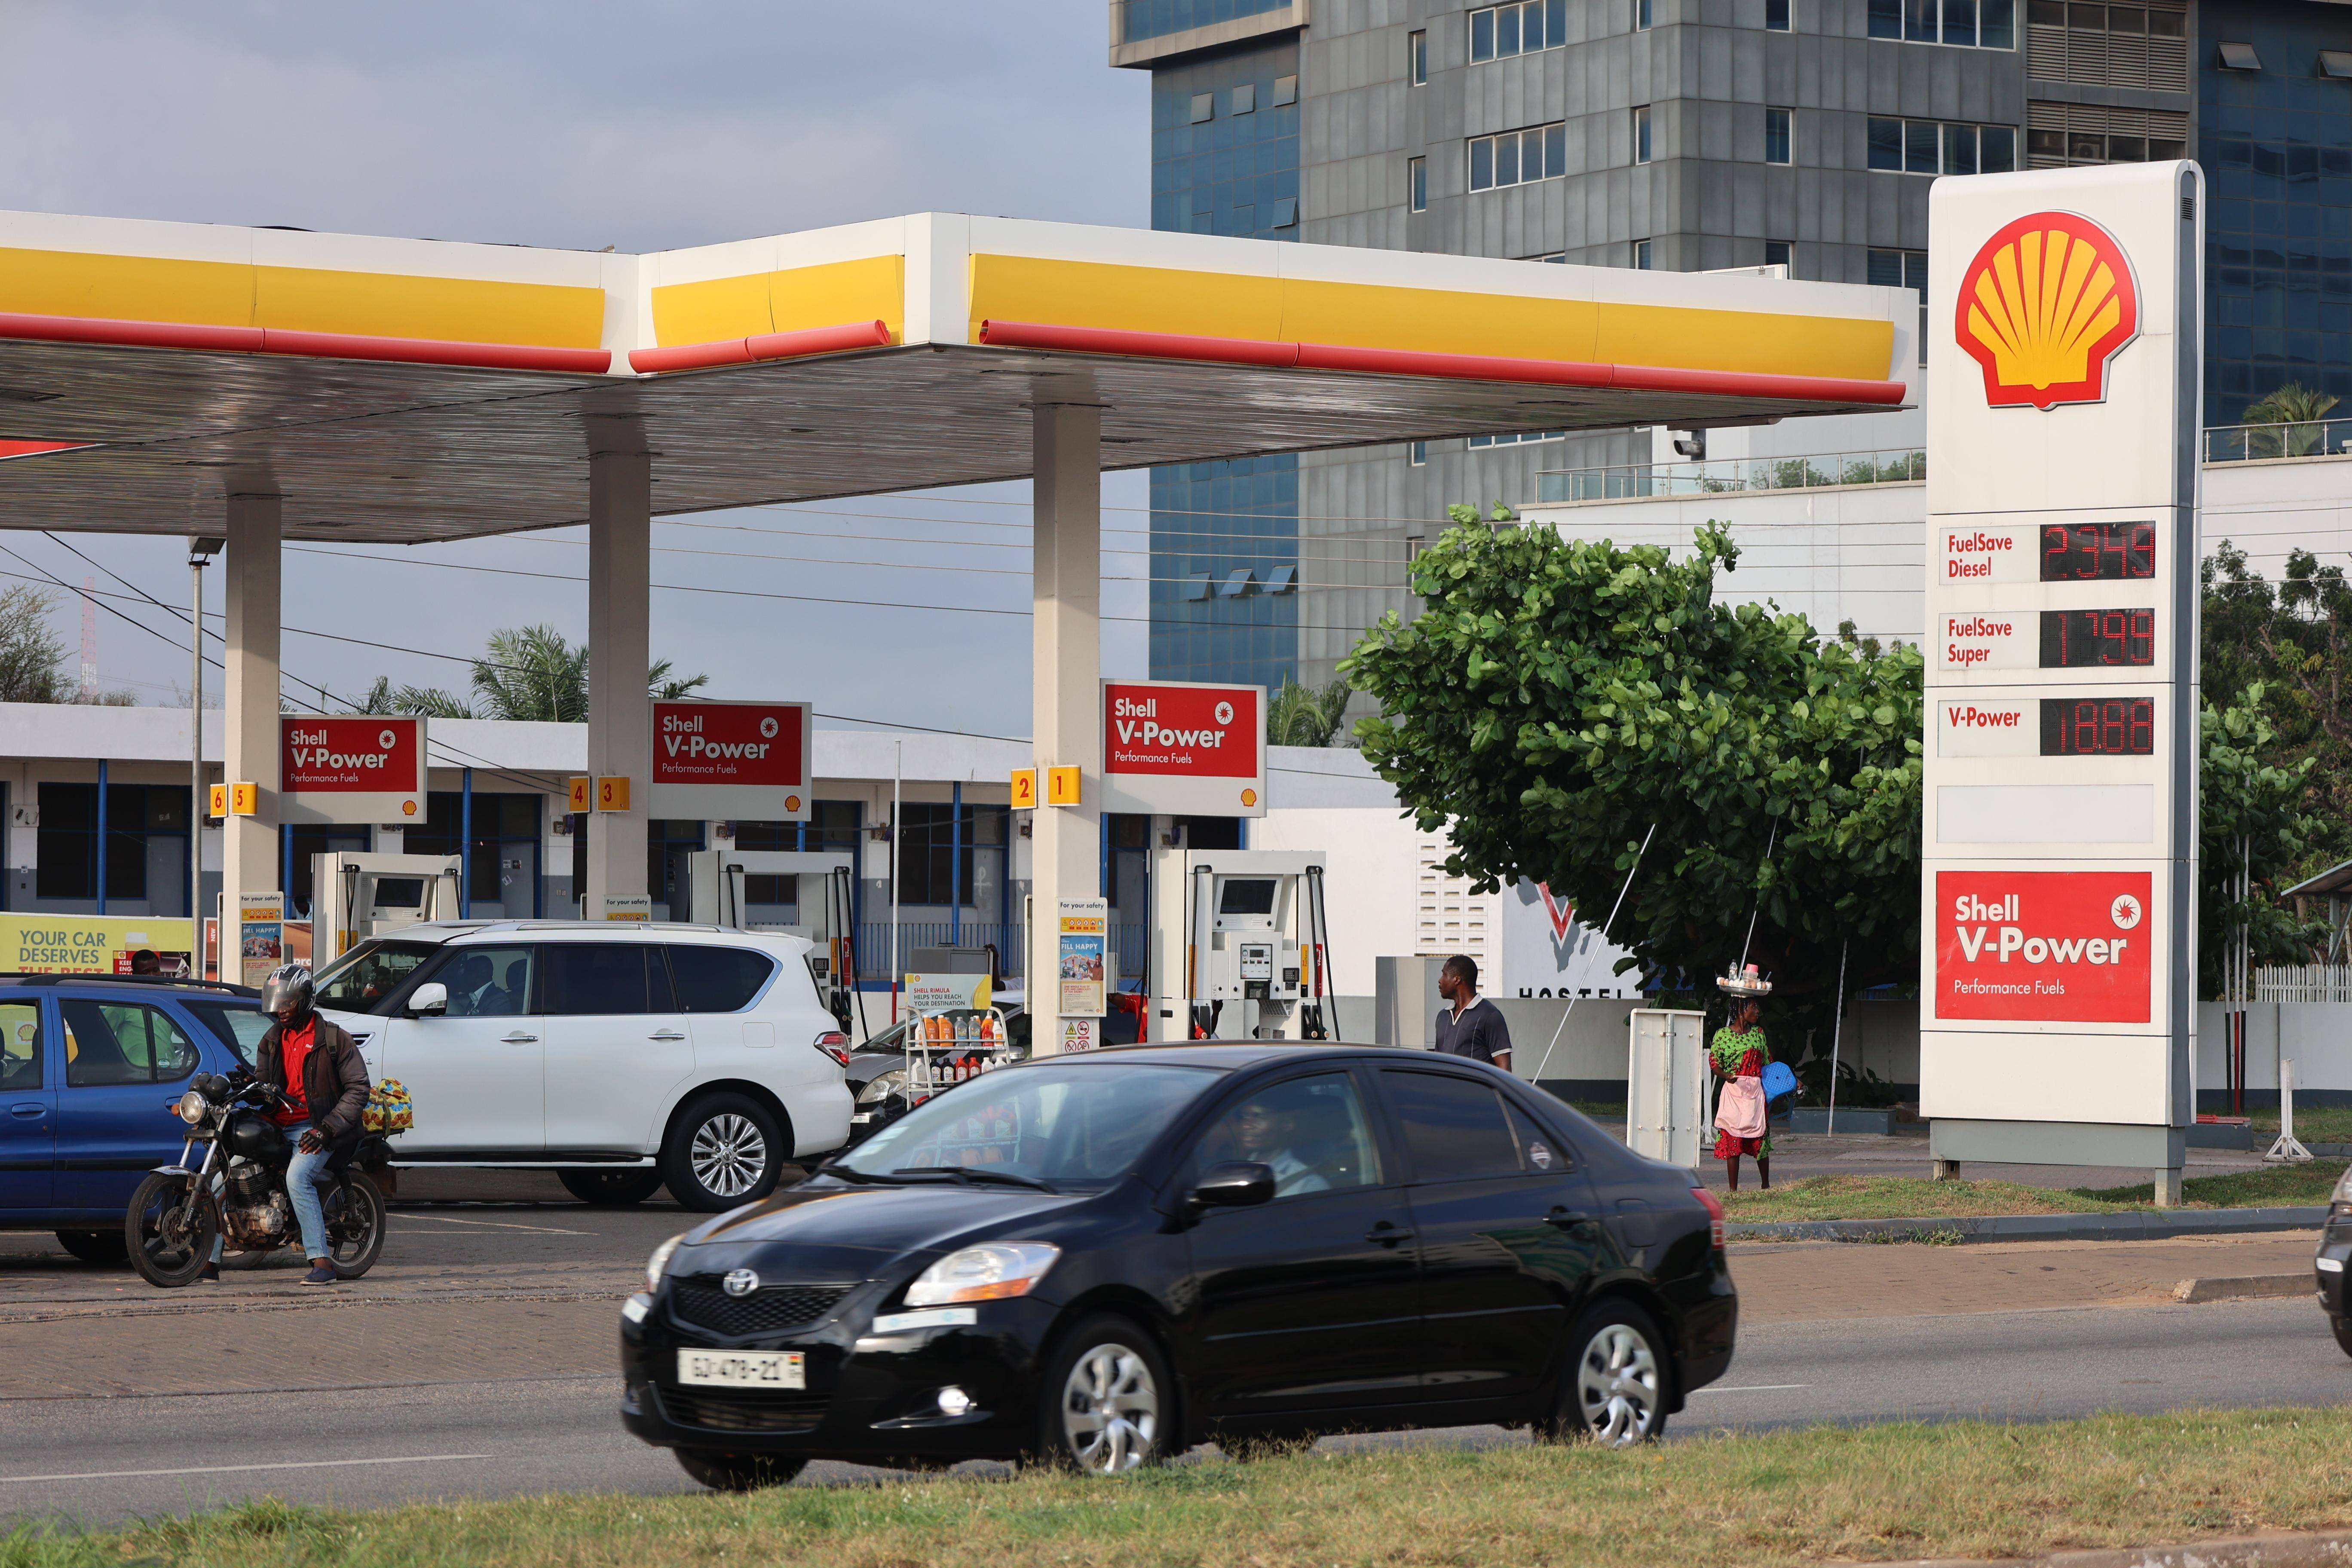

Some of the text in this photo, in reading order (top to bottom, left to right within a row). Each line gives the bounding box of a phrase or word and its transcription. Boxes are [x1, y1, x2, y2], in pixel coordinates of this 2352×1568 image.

[1948, 532, 2013, 553] FuelSave
[1948, 556, 1991, 578] Diesel
[1948, 616, 2012, 637] FuelSave
[1948, 643, 1990, 667] Super
[1115, 697, 1156, 718] Shell
[1948, 706, 2021, 727] V-Power
[662, 714, 703, 732] Shell
[290, 729, 327, 745] Shell
[1115, 720, 1225, 748] V-Power
[663, 735, 770, 760] V-Power
[1115, 750, 1192, 764] Performance Fuels
[291, 747, 388, 769] V-Power
[290, 773, 359, 783] Performance Fuels
[662, 763, 737, 774] Performance Fuels
[574, 785, 583, 803] 4
[603, 783, 612, 802] 3
[1019, 778, 1029, 798] 2
[1057, 775, 1062, 796] 1
[215, 792, 222, 808] 6
[236, 790, 243, 806] 5
[1086, 902, 1104, 910] safety
[1955, 894, 2018, 922] Shell
[19, 930, 106, 947] YOUR CAR
[1955, 925, 2128, 965] V-Power
[19, 947, 99, 964] DESERVES
[1954, 978, 2065, 995] Performance Fuels
